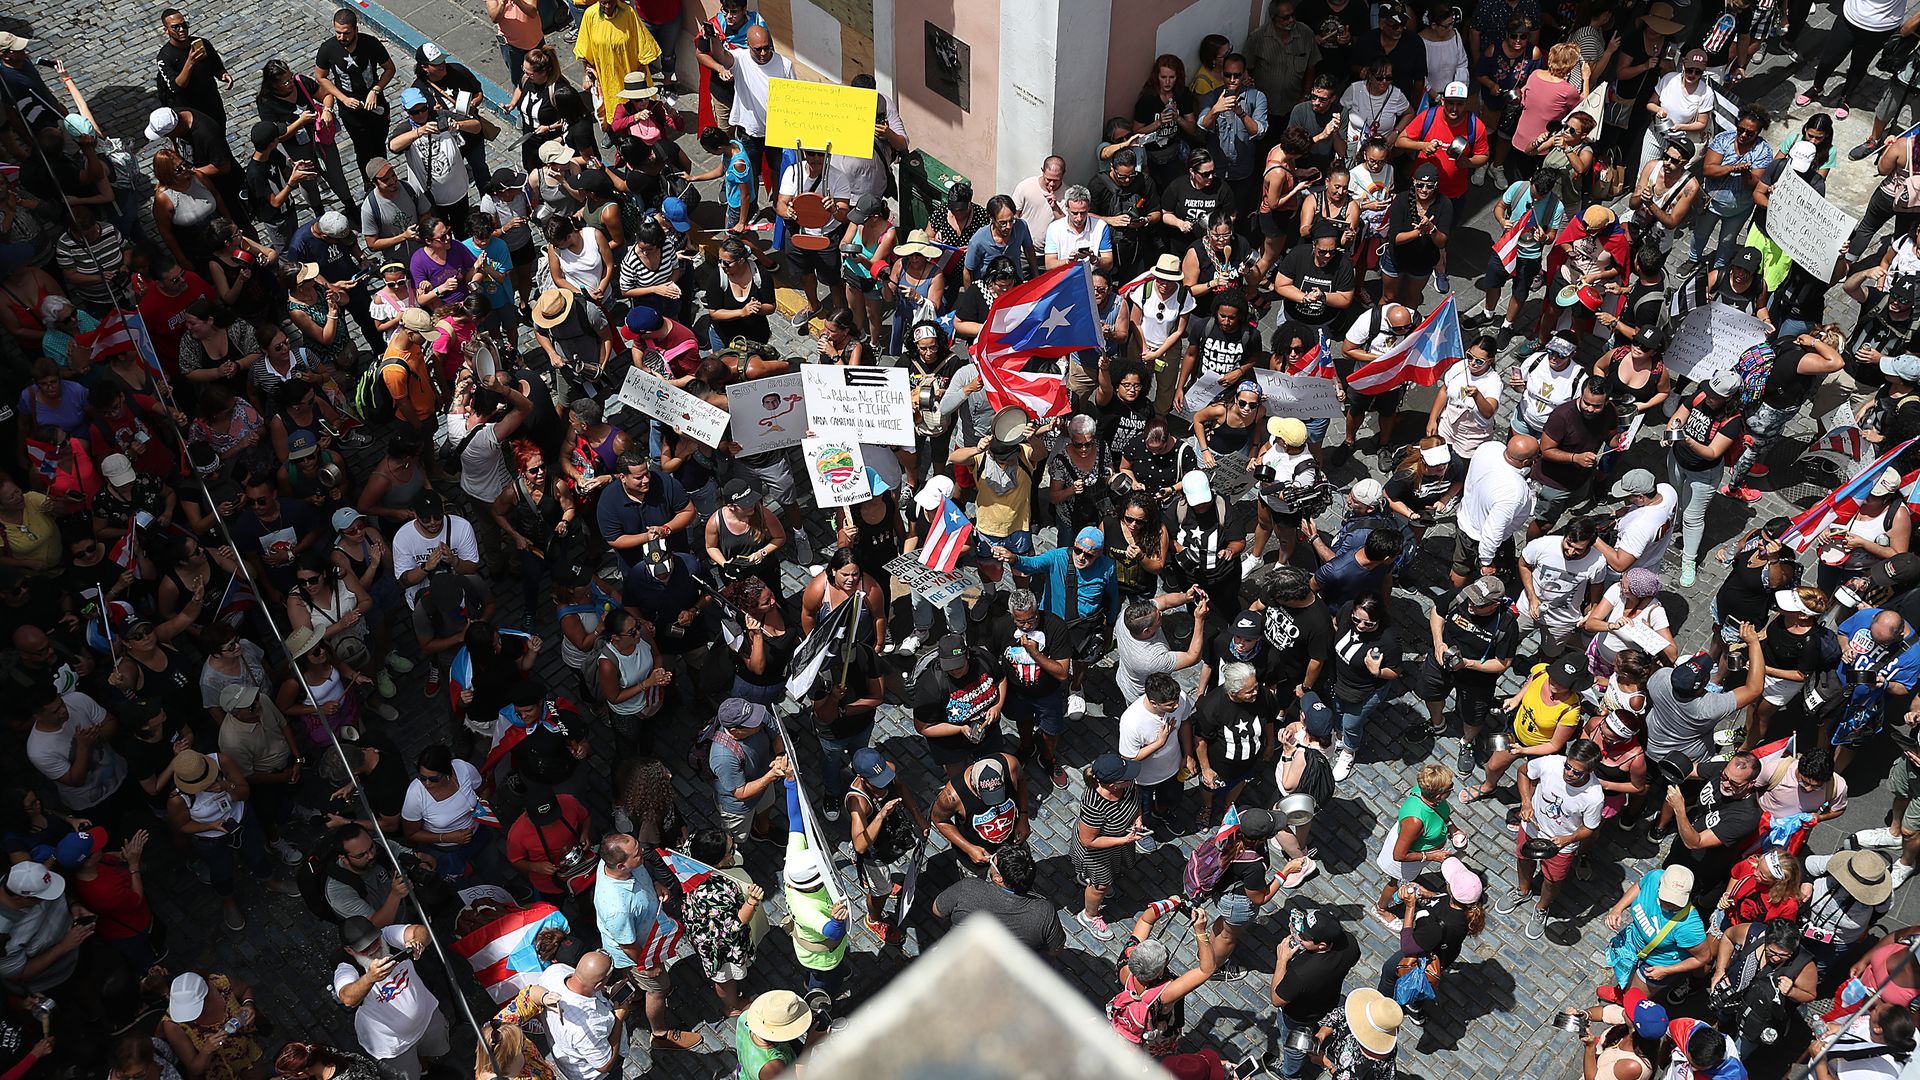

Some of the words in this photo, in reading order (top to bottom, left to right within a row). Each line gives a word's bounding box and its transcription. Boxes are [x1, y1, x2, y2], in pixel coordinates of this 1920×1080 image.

[1184, 199, 1204, 208] PUERTO
[1204, 199, 1216, 208] RICO
[1205, 337, 1244, 355] SALSA
[732, 382, 758, 399] SOY
[858, 390, 873, 403] Nos
[875, 390, 905, 405] FECHA
[842, 404, 855, 414] Nos
[1274, 403, 1320, 413] Boricua
[857, 418, 864, 428] LO
[1687, 415, 1708, 435] VIVOS
[891, 560, 923, 577] BIENV
[916, 584, 932, 594] DEL
[932, 576, 946, 587] YO
[945, 571, 964, 582] NO
[929, 590, 947, 603] ME
[945, 578, 973, 594] DEJO
[1857, 637, 1874, 650] VOTE
[1632, 903, 1656, 938] PUMA
